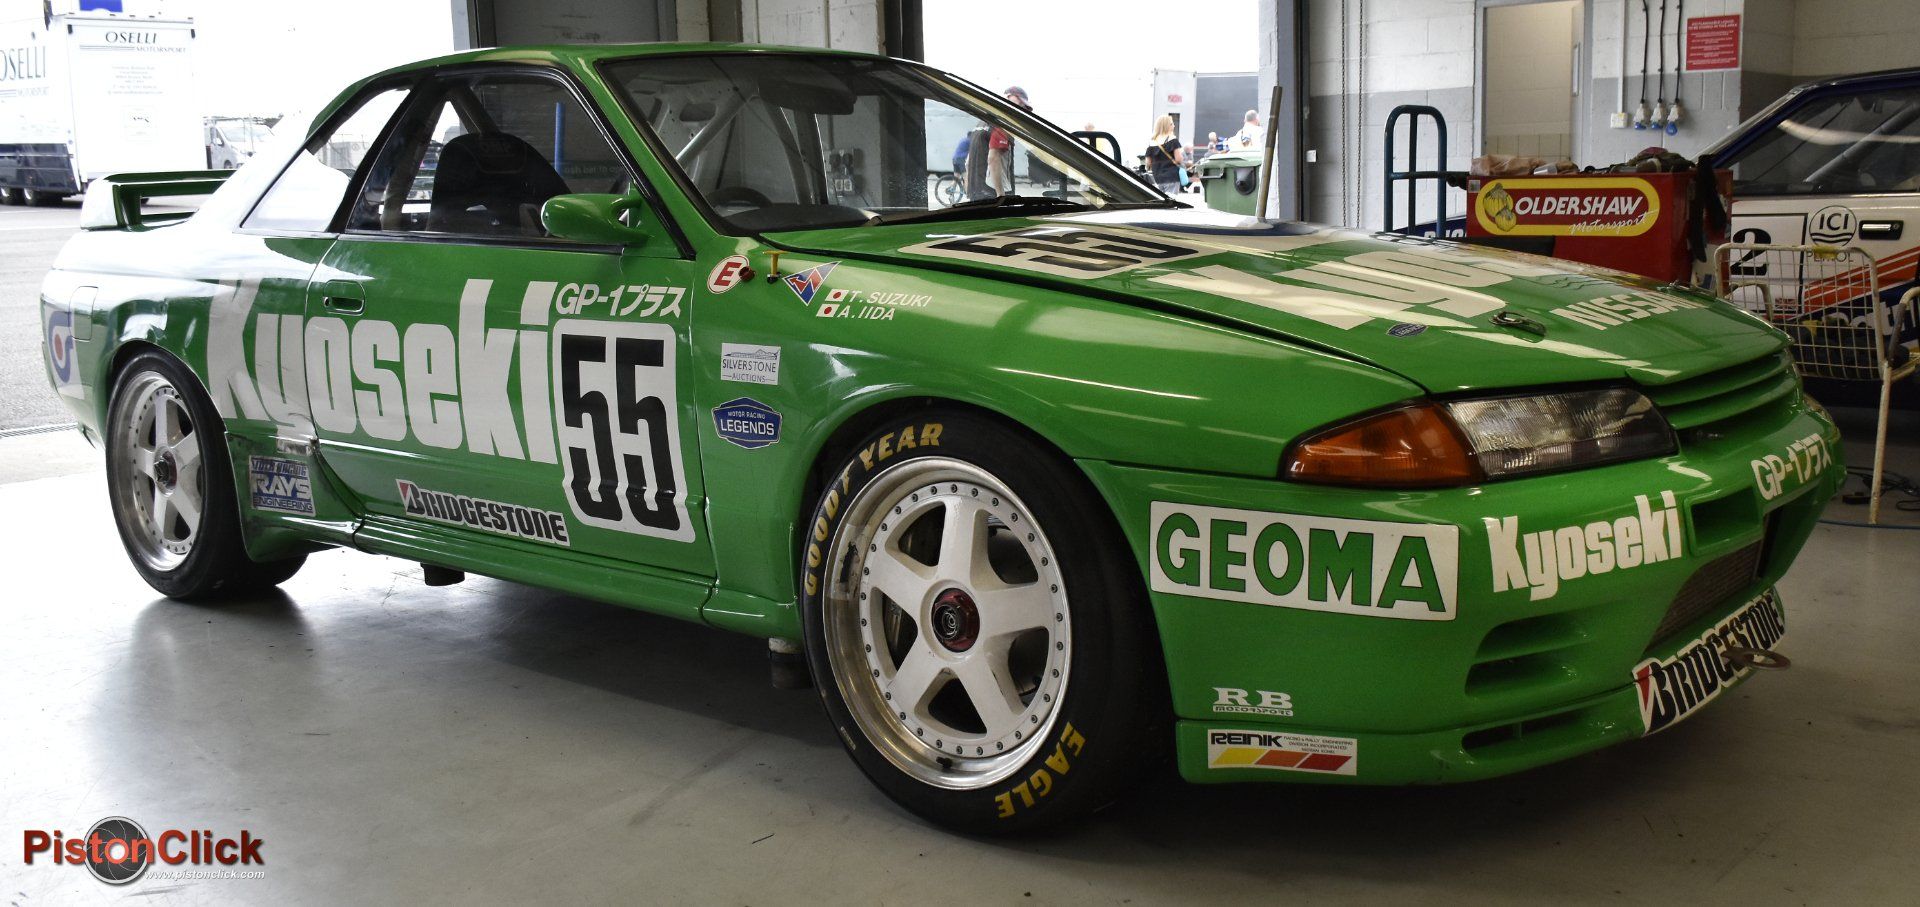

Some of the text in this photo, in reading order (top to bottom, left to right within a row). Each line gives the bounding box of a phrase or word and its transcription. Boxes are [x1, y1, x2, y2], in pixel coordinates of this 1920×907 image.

[106, 31, 157, 44] OSELLI
[1515, 196, 1643, 216] OLDERSHAW
[1568, 210, 1659, 235] Motorsport
[1819, 213, 1850, 231] ICI
[927, 225, 1199, 272] 55
[714, 261, 742, 287] E
[556, 282, 687, 318] GP-1プラス
[1549, 291, 1710, 331] NISSAN
[207, 278, 558, 465] Kyoseki
[722, 359, 776, 373] SILVERSTONE
[732, 373, 766, 383] AUCTIONS
[720, 419, 775, 436] LEGENDS
[747, 412, 766, 420] RACING
[561, 333, 680, 531] 55
[251, 474, 312, 499] RAYS
[253, 497, 313, 511] ENGINEERING
[401, 482, 569, 542] BRIDGESTONE
[1482, 489, 1682, 602] Kyoseki
[1156, 512, 1447, 613] GEOMA
[1637, 593, 1785, 731] BRIDGESTONE
[995, 721, 1086, 818] EAGLE
